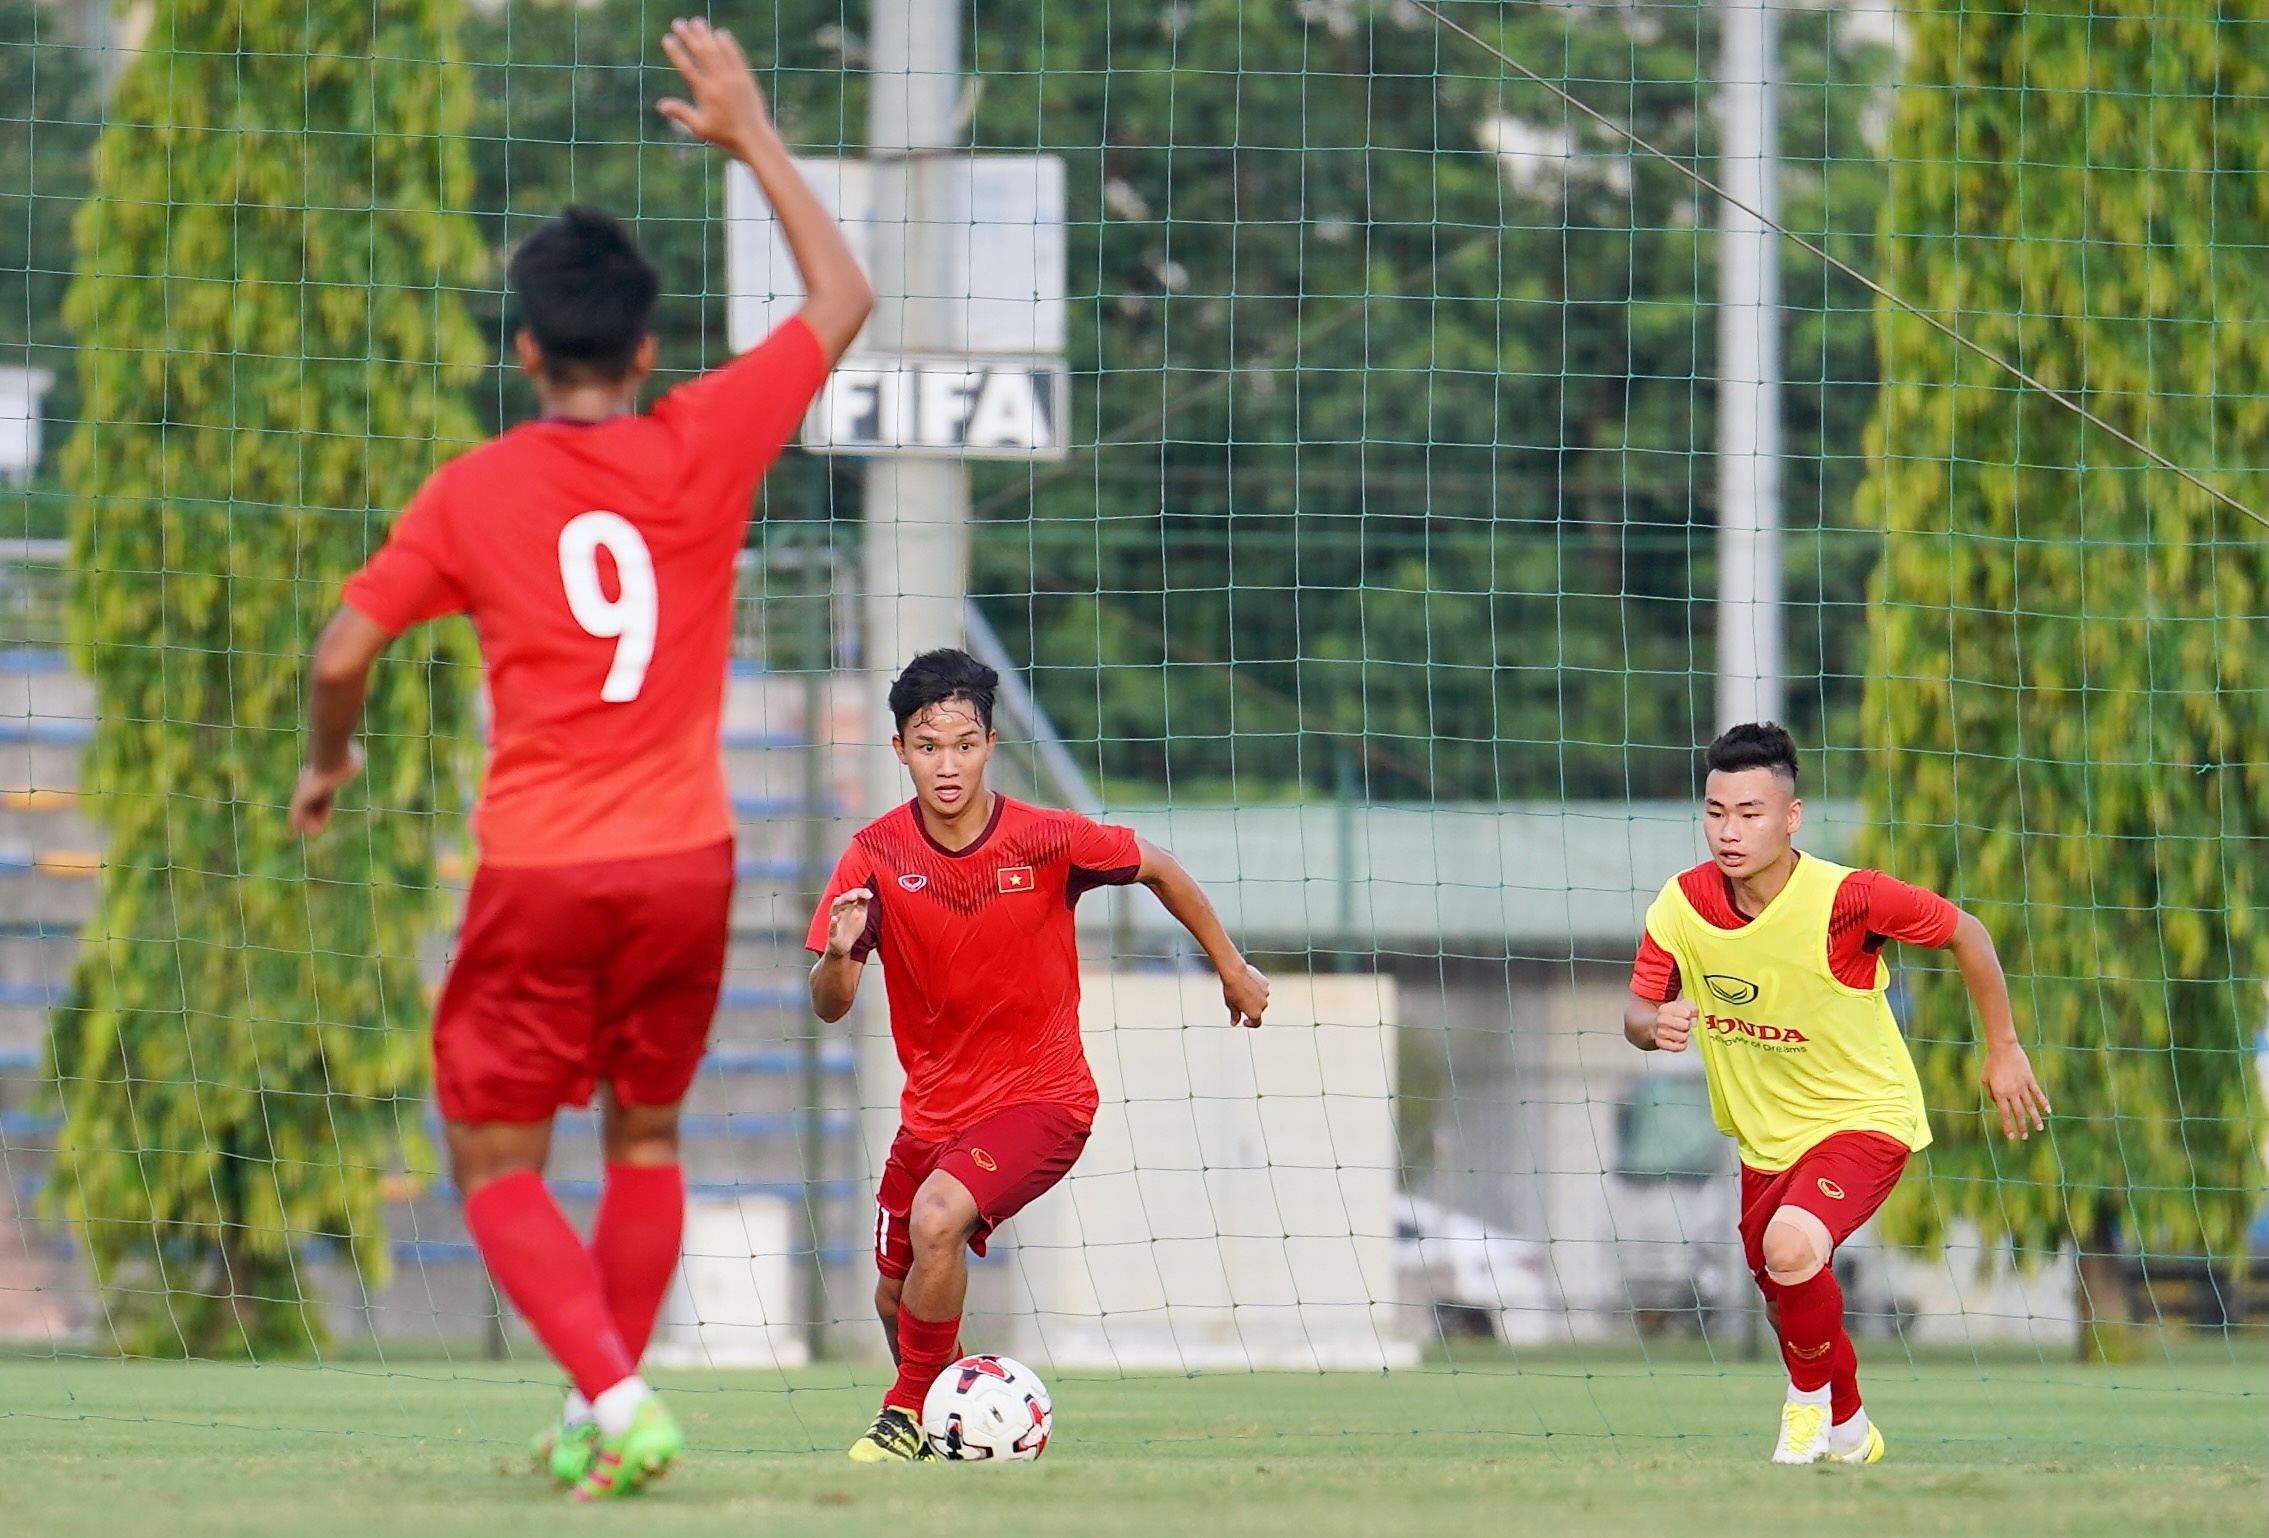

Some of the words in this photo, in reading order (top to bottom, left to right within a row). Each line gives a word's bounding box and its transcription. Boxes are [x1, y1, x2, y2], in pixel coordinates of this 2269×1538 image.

[818, 365, 1054, 446] FIFA
[558, 510, 659, 702] 9
[1762, 1043, 1807, 1053] Dreams
